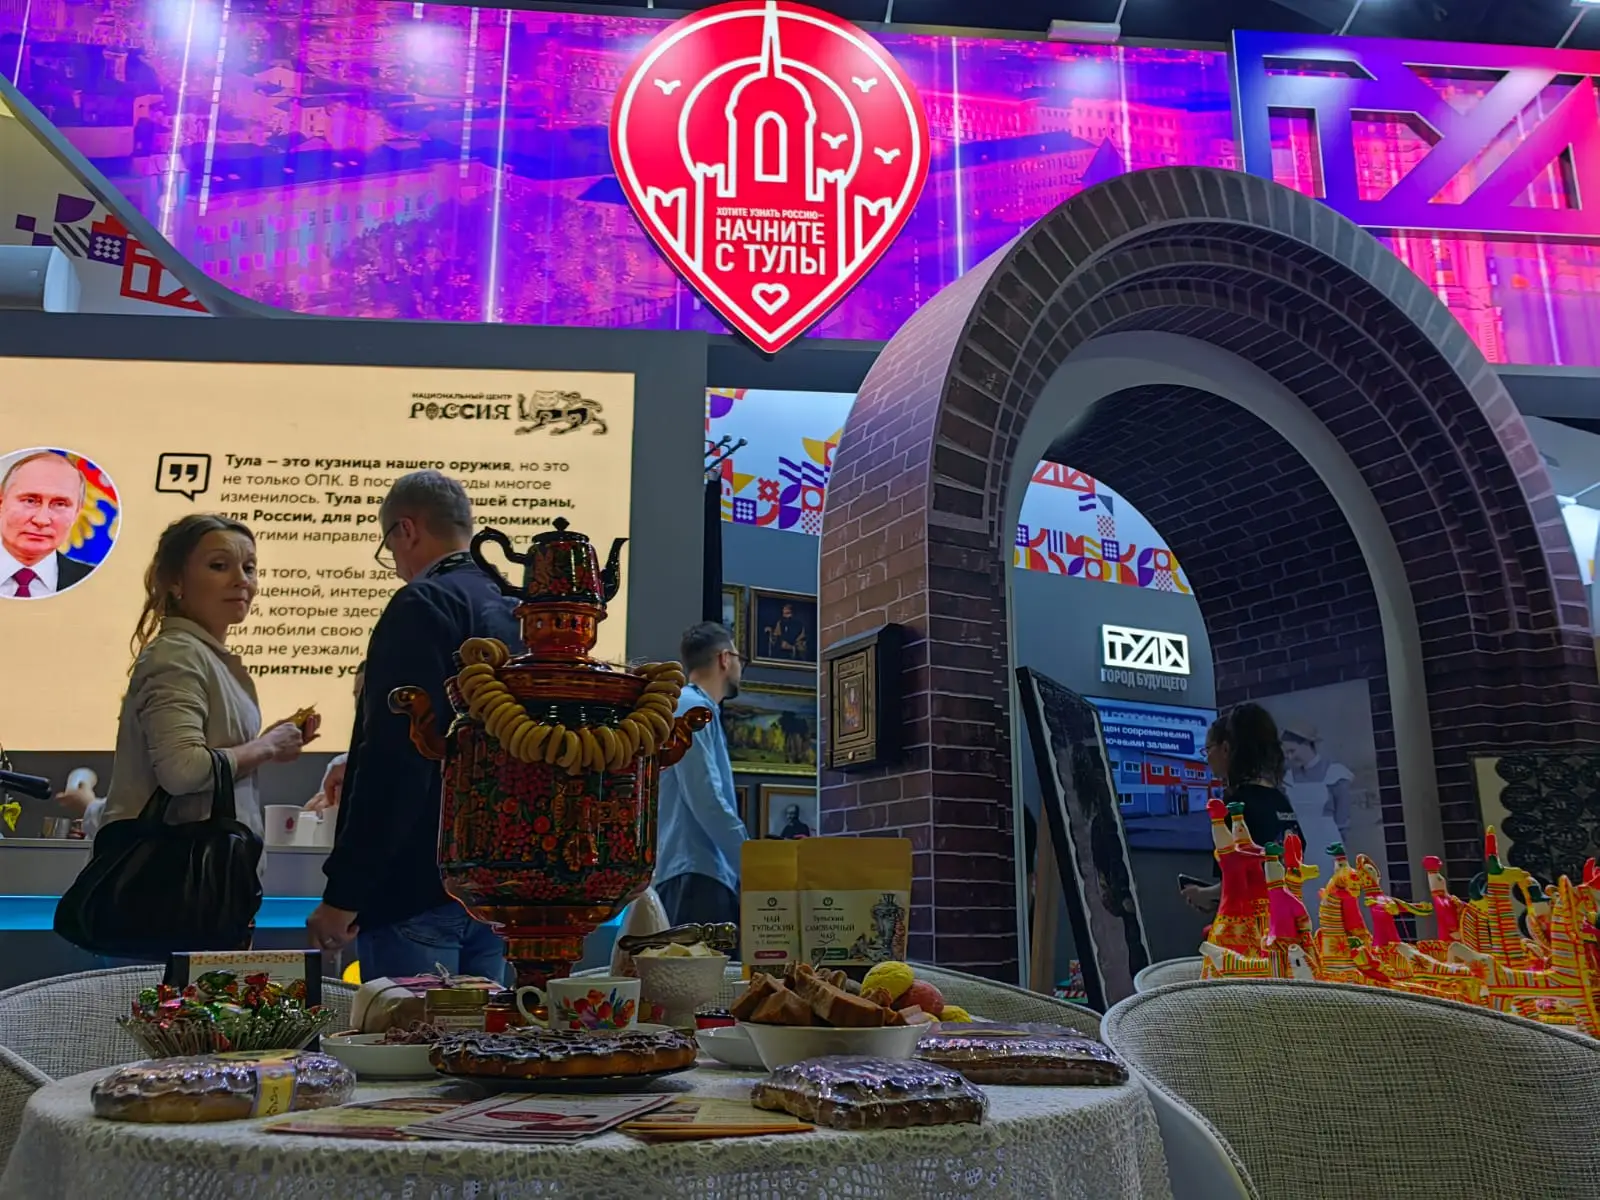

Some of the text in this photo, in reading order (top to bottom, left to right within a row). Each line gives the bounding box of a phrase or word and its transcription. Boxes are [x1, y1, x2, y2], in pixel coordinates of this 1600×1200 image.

[716, 207, 748, 217] ХОТИТЕ
[750, 208, 781, 218] УЗНАТЬ
[716, 218, 825, 244] НАЧНИТЕ
[715, 242, 826, 275] С ТУЛЫ
[412, 392, 513, 401] НАЦИОНАЛЬНЫЙ ЦЕНТР
[409, 402, 513, 420] РОССИЯ
[225, 454, 262, 468] Тула
[282, 457, 310, 468] это
[315, 458, 381, 469] кузница
[386, 459, 445, 471] нашего
[450, 460, 514, 474] оружия,
[519, 462, 539, 472] но
[543, 462, 570, 472] это
[223, 475, 242, 485] не
[246, 475, 300, 486] только
[304, 473, 344, 487] ОПК.
[350, 474, 359, 487] В
[461, 479, 552, 490] оды многое
[220, 492, 320, 504] изменилось.
[325, 492, 362, 506] Тула
[512, 497, 576, 509] страны,
[253, 509, 317, 523] России,
[321, 513, 351, 523] для
[272, 568, 311, 580] того,
[316, 567, 365, 579] чтобы
[369, 570, 397, 580] зде
[257, 585, 396, 599] ценной, интерес
[269, 606, 338, 619] которые
[252, 624, 316, 636] любили
[321, 626, 364, 636] свою
[268, 644, 288, 655] не
[292, 645, 364, 657] уезжали,
[1102, 624, 1190, 675] ТУЛА
[244, 664, 334, 678] приятные
[1101, 668, 1188, 692] ГОРОД БУДУЩЕГО
[763, 914, 780, 923] ЧАЙ
[752, 924, 794, 933] ТУЛЬСКИЙ
[805, 924, 855, 933] САМОВАРНЫЙ
